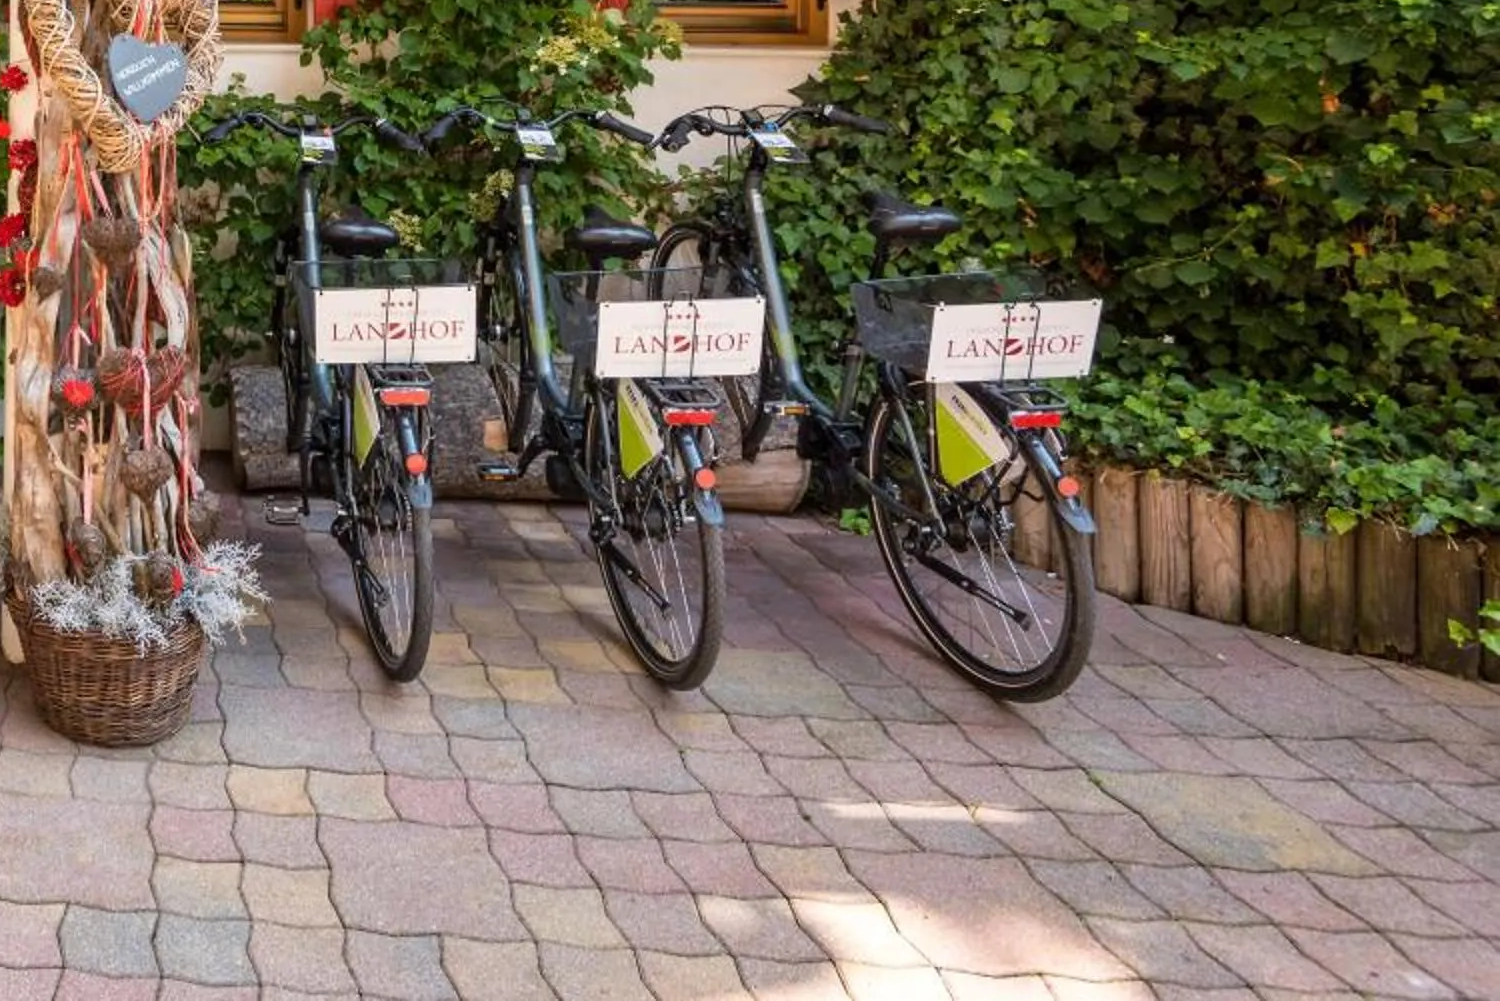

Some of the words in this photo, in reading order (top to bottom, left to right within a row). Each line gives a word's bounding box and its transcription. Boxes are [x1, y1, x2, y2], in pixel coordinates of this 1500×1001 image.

[331, 319, 465, 342] LANDHOF
[613, 331, 752, 356] LANDHOF
[946, 334, 1085, 359] LANDHOF
